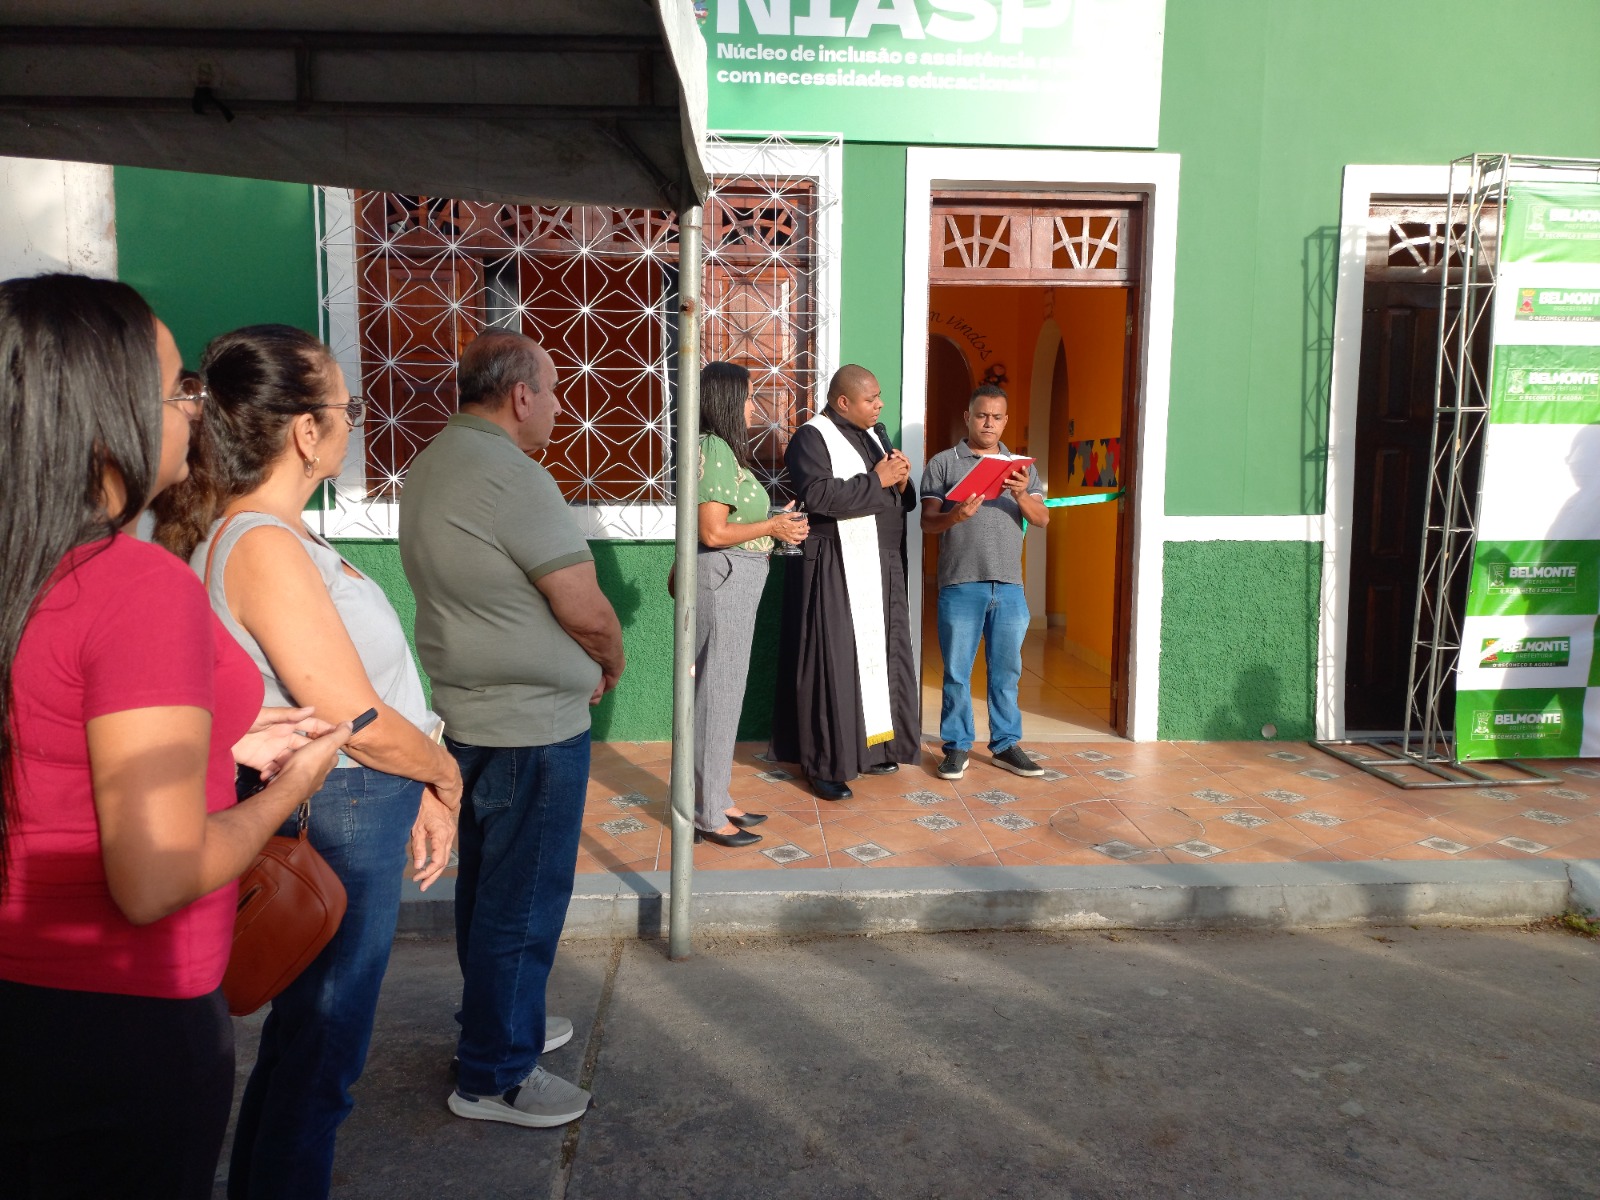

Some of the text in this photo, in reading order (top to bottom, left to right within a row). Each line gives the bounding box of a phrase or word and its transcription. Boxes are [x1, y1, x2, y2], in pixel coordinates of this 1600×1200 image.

[717, 42, 788, 61] Núcleo
[790, 44, 816, 62] de
[818, 44, 902, 64] inclusão
[904, 51, 918, 65] e
[716, 70, 761, 83] com
[763, 68, 905, 88] necessidades
[946, 315, 993, 362] vindos
[1529, 372, 1598, 384] BELMONTE
[1509, 566, 1577, 578] BELMONTE
[1502, 640, 1569, 652] BELMONTE
[1495, 713, 1561, 725] BELMONTE
